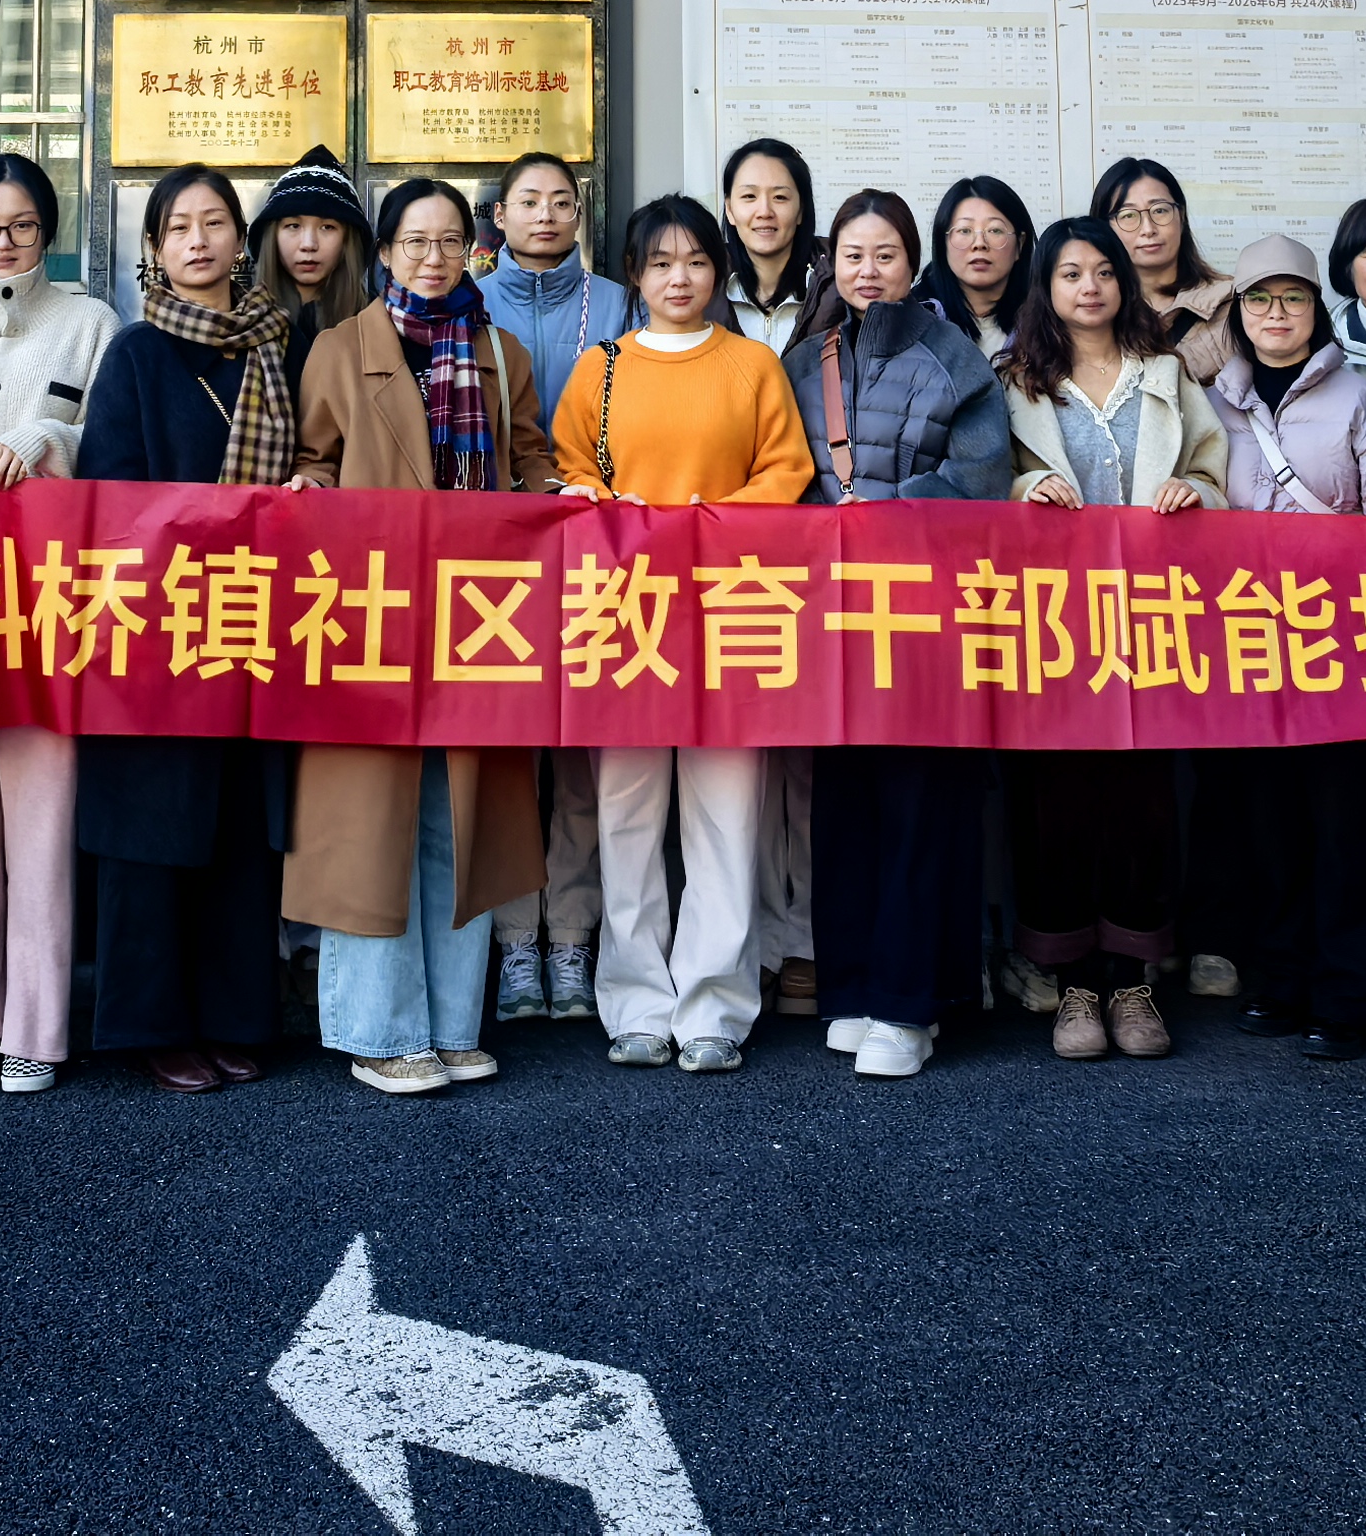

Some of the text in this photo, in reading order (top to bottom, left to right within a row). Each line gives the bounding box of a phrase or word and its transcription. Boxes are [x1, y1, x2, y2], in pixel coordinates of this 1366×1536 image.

[193, 35, 264, 56] 杭州市
[445, 37, 515, 57] 杭州市
[139, 67, 322, 100] 职工教育先进单位
[392, 69, 570, 94] 职工教育培训示范基地
